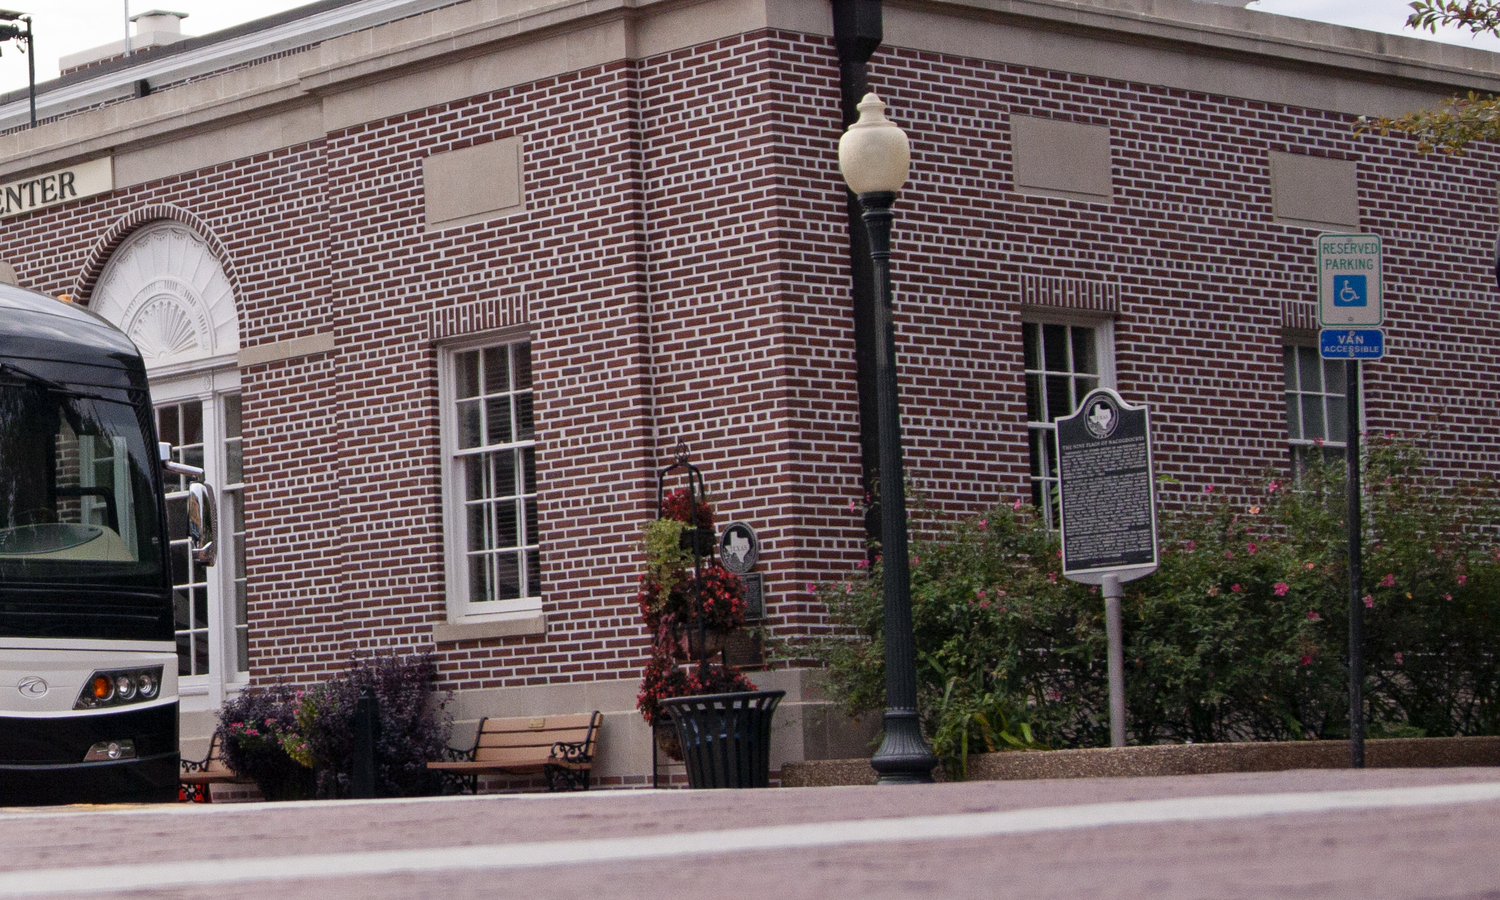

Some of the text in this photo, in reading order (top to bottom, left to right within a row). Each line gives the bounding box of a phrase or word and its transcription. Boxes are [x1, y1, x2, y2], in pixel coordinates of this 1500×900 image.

[1322, 242, 1378, 254] RESERVED
[1325, 258, 1374, 270] PARKING
[1337, 335, 1364, 344] VAN
[1323, 345, 1380, 353] ACCESSIBLE
